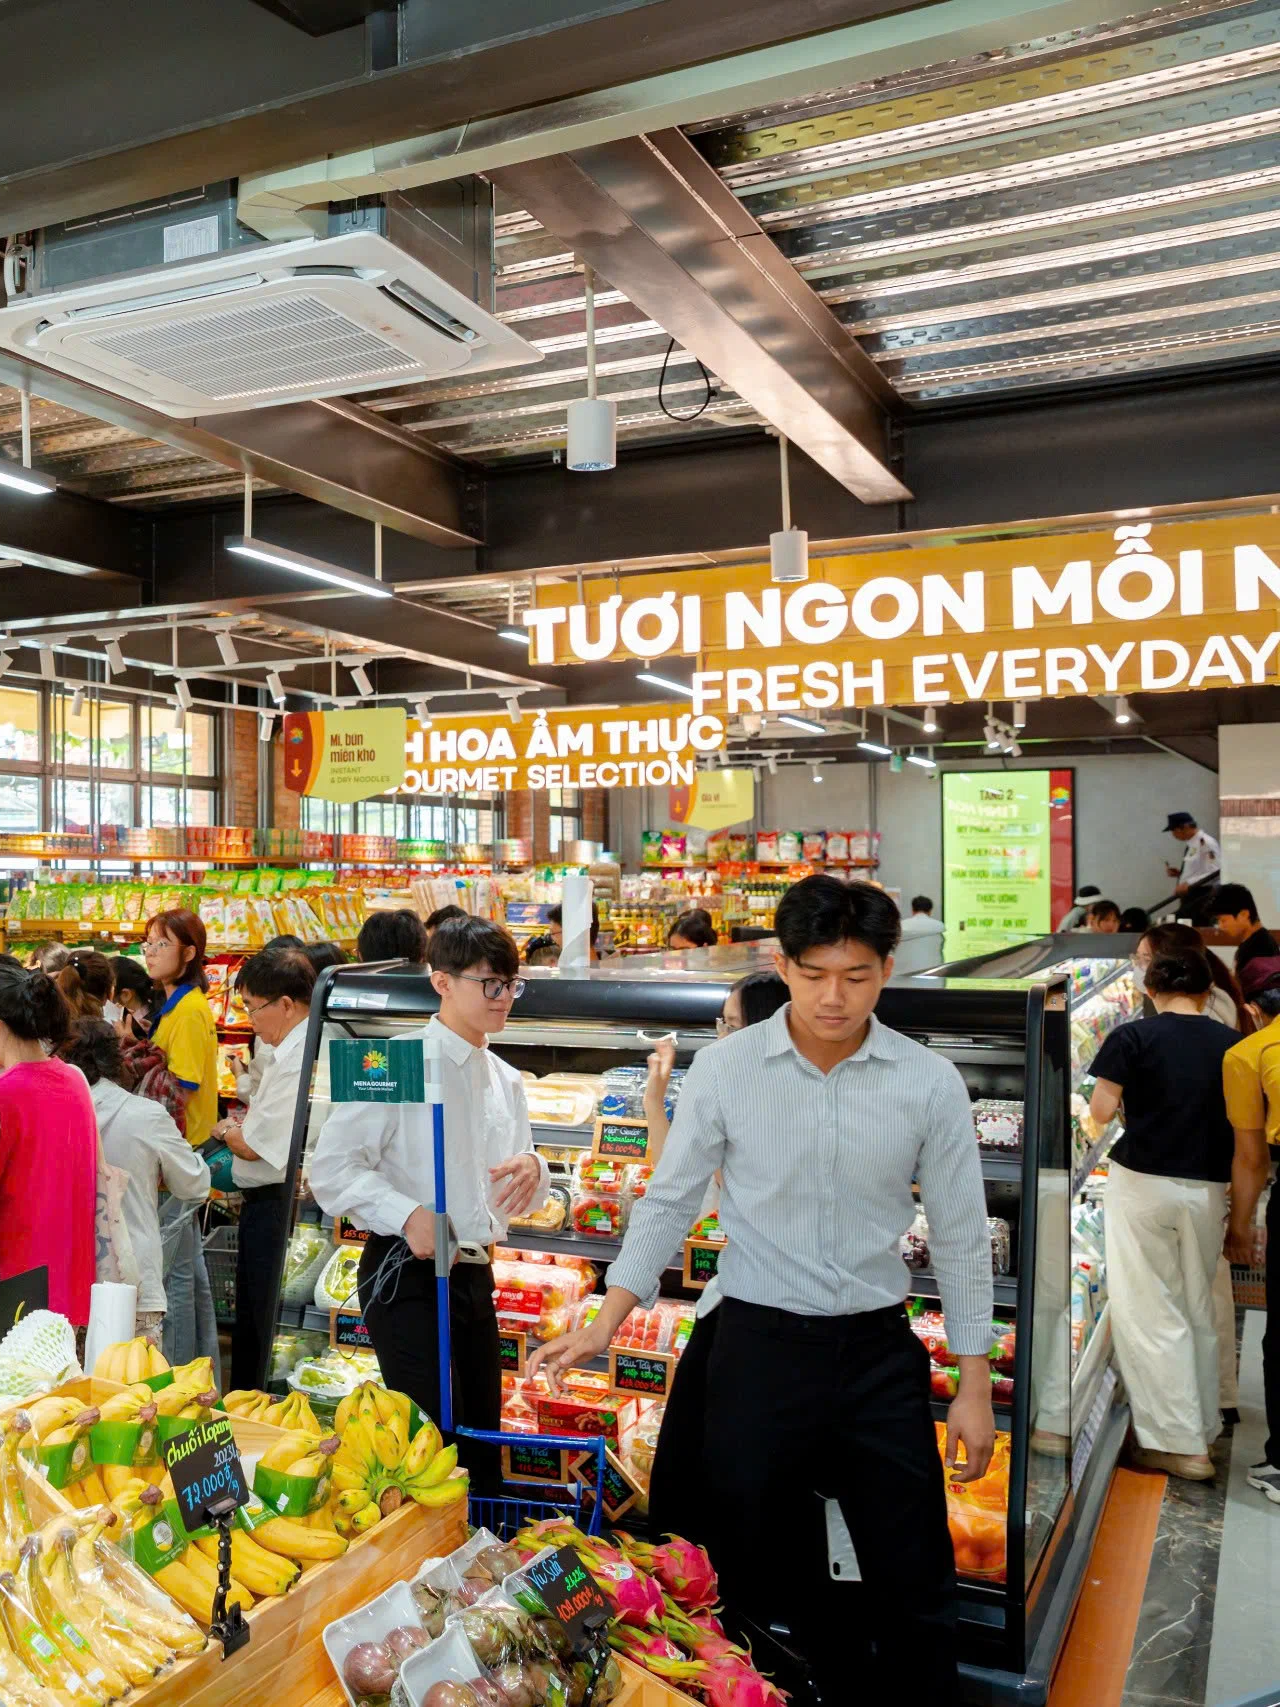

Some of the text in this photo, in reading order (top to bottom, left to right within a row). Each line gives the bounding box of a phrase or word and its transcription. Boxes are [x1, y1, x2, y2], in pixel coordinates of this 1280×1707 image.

[522, 594, 701, 665] TƯƠI
[726, 570, 985, 650] NGON
[1011, 523, 1204, 627] MỖI
[691, 632, 1280, 716] FRESH EVERYDAY
[431, 727, 519, 762] HOA
[526, 708, 595, 758] ẨM
[602, 712, 723, 764] THỰC
[384, 759, 695, 795] OURMET SELECTION
